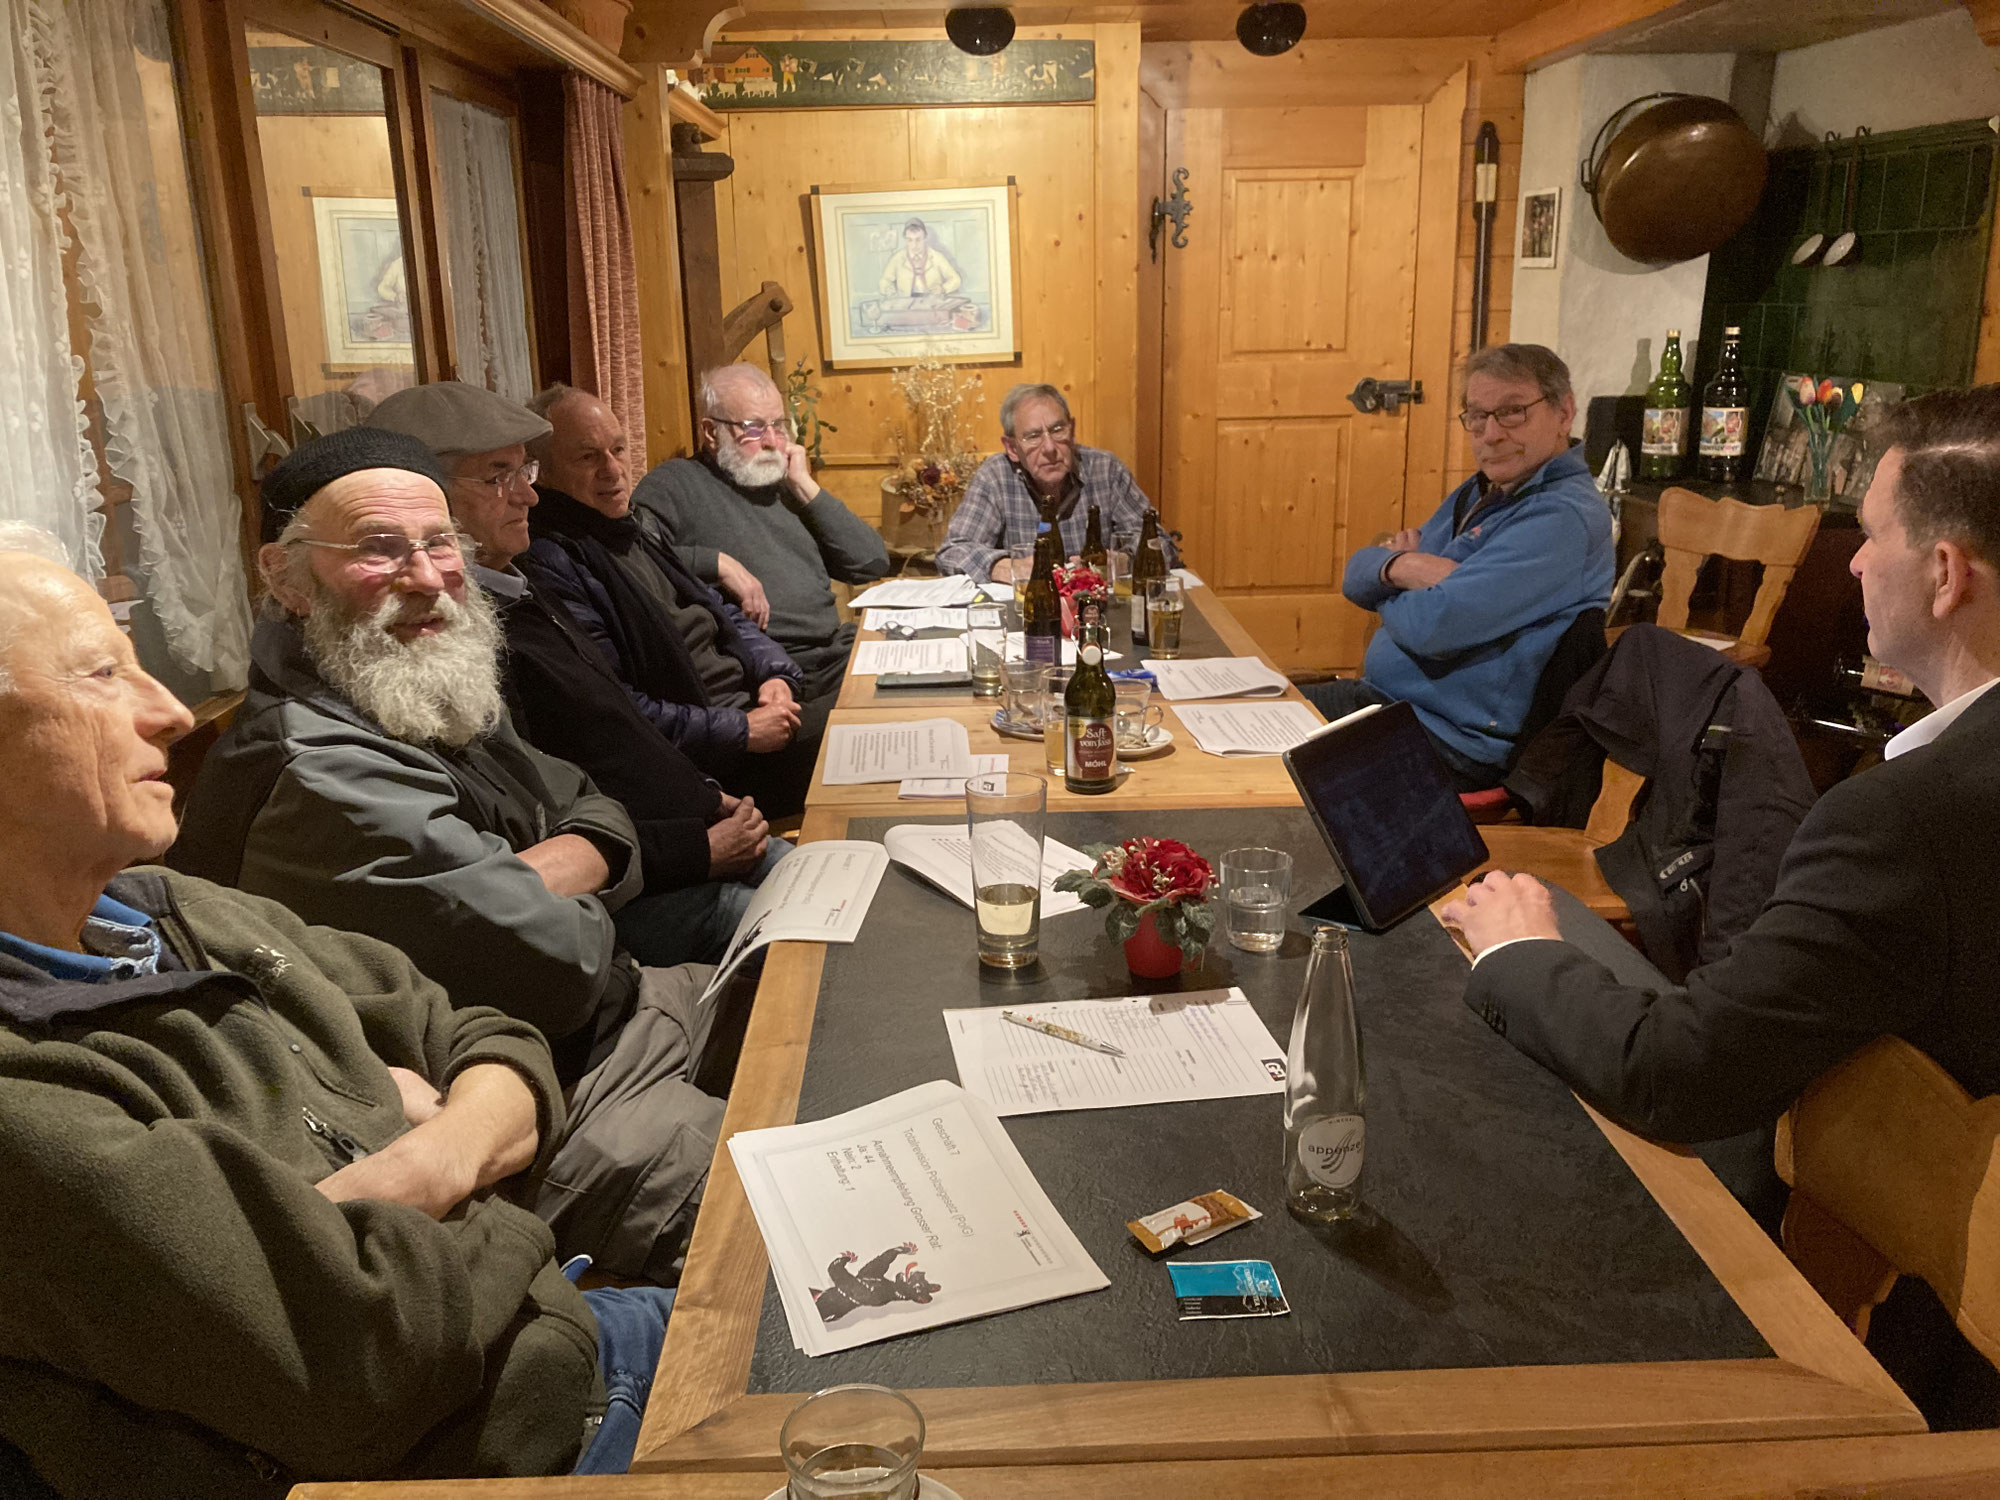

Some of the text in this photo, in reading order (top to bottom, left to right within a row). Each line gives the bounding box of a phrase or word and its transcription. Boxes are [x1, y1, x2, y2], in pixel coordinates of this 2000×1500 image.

[864, 1155, 876, 1164] 44
[872, 1139, 916, 1207] Annahmeempfehlung
[911, 1206, 933, 1234] Grosser
[904, 1127, 932, 1171] Totalrevision
[926, 1170, 959, 1214] Polizeigesetz
